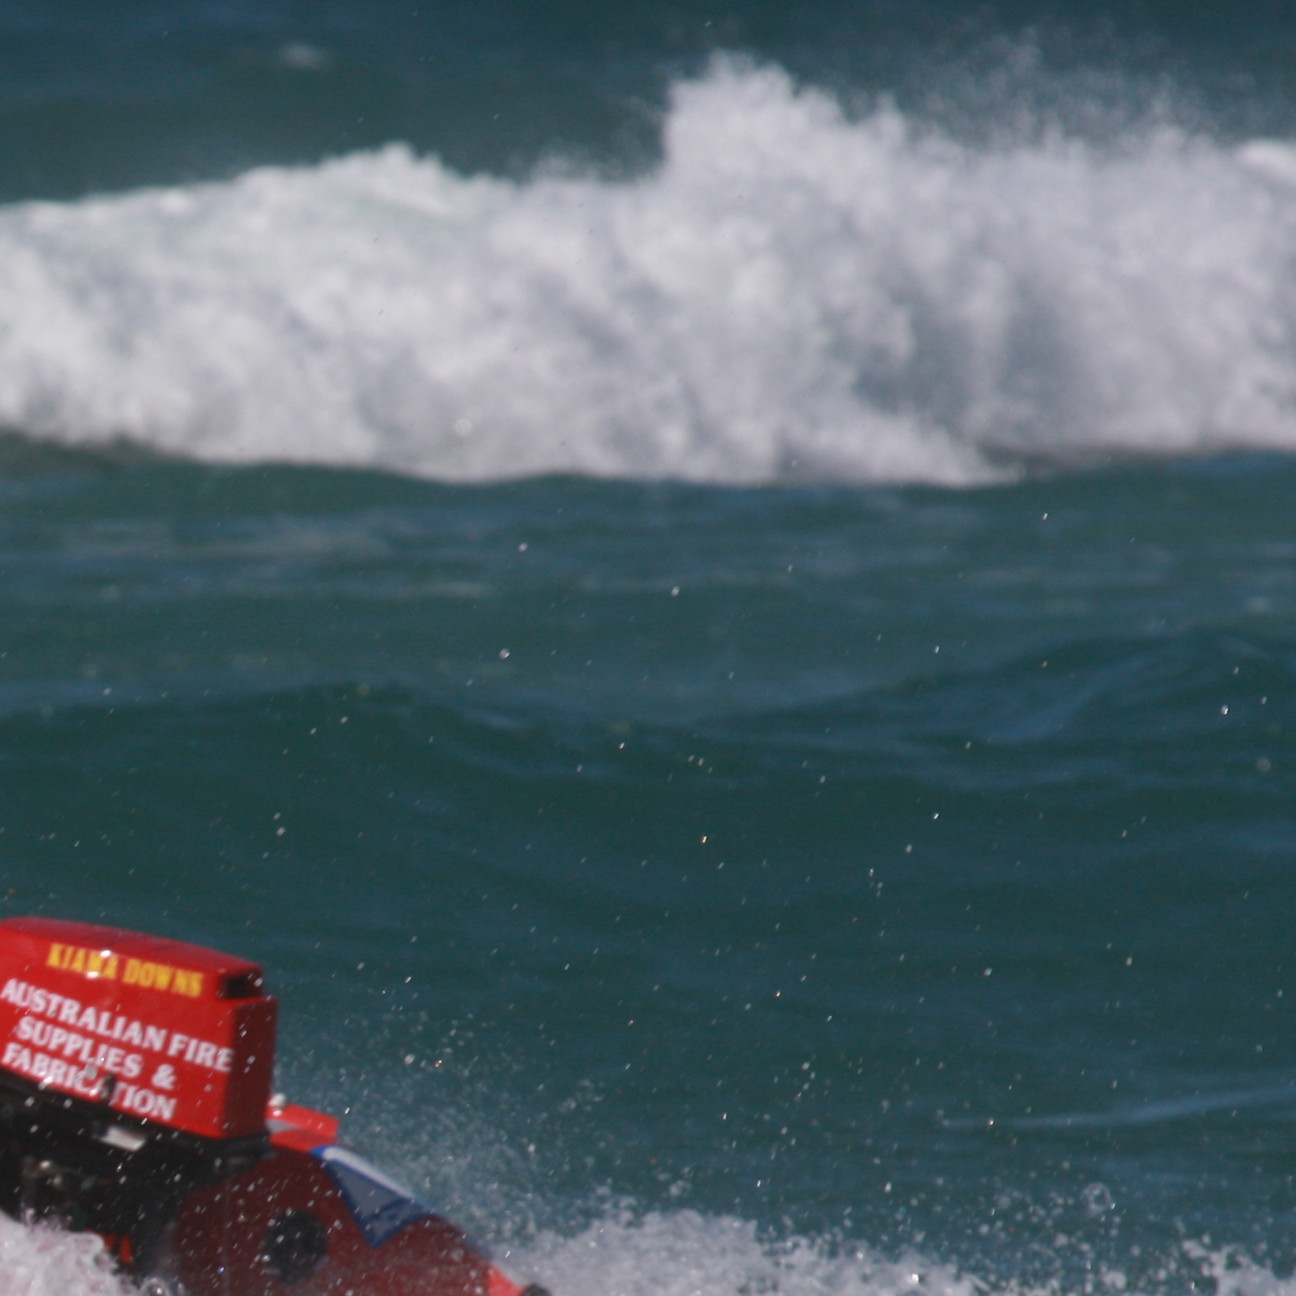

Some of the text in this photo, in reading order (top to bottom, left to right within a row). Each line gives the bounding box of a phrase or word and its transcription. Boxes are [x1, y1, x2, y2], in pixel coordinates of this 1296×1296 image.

[46, 942, 204, 998] KIAMA DOWNS
[15, 1015, 177, 1090] SUPPLIES &
[167, 1033, 235, 1072] FIRE
